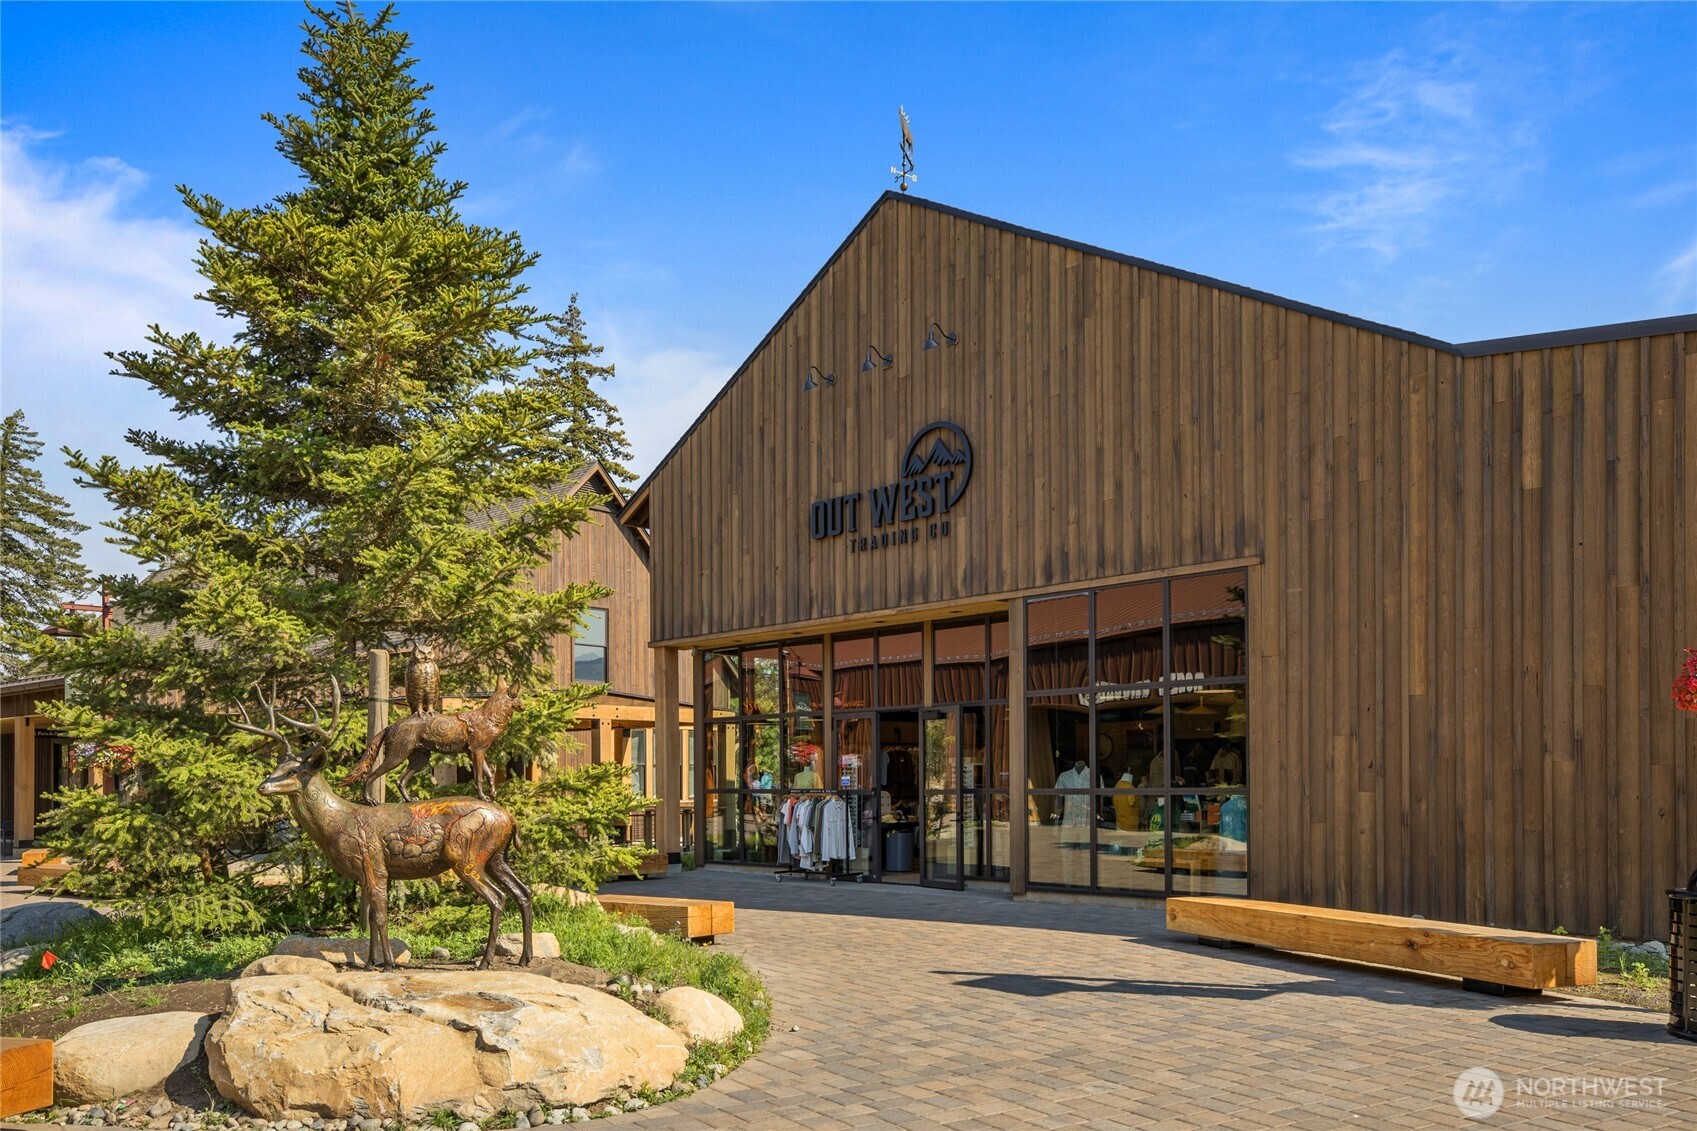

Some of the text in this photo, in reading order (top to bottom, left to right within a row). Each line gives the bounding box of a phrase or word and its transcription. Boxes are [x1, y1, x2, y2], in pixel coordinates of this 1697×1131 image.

[811, 470, 953, 540] OUT WEST
[850, 521, 949, 553] TRADING CO
